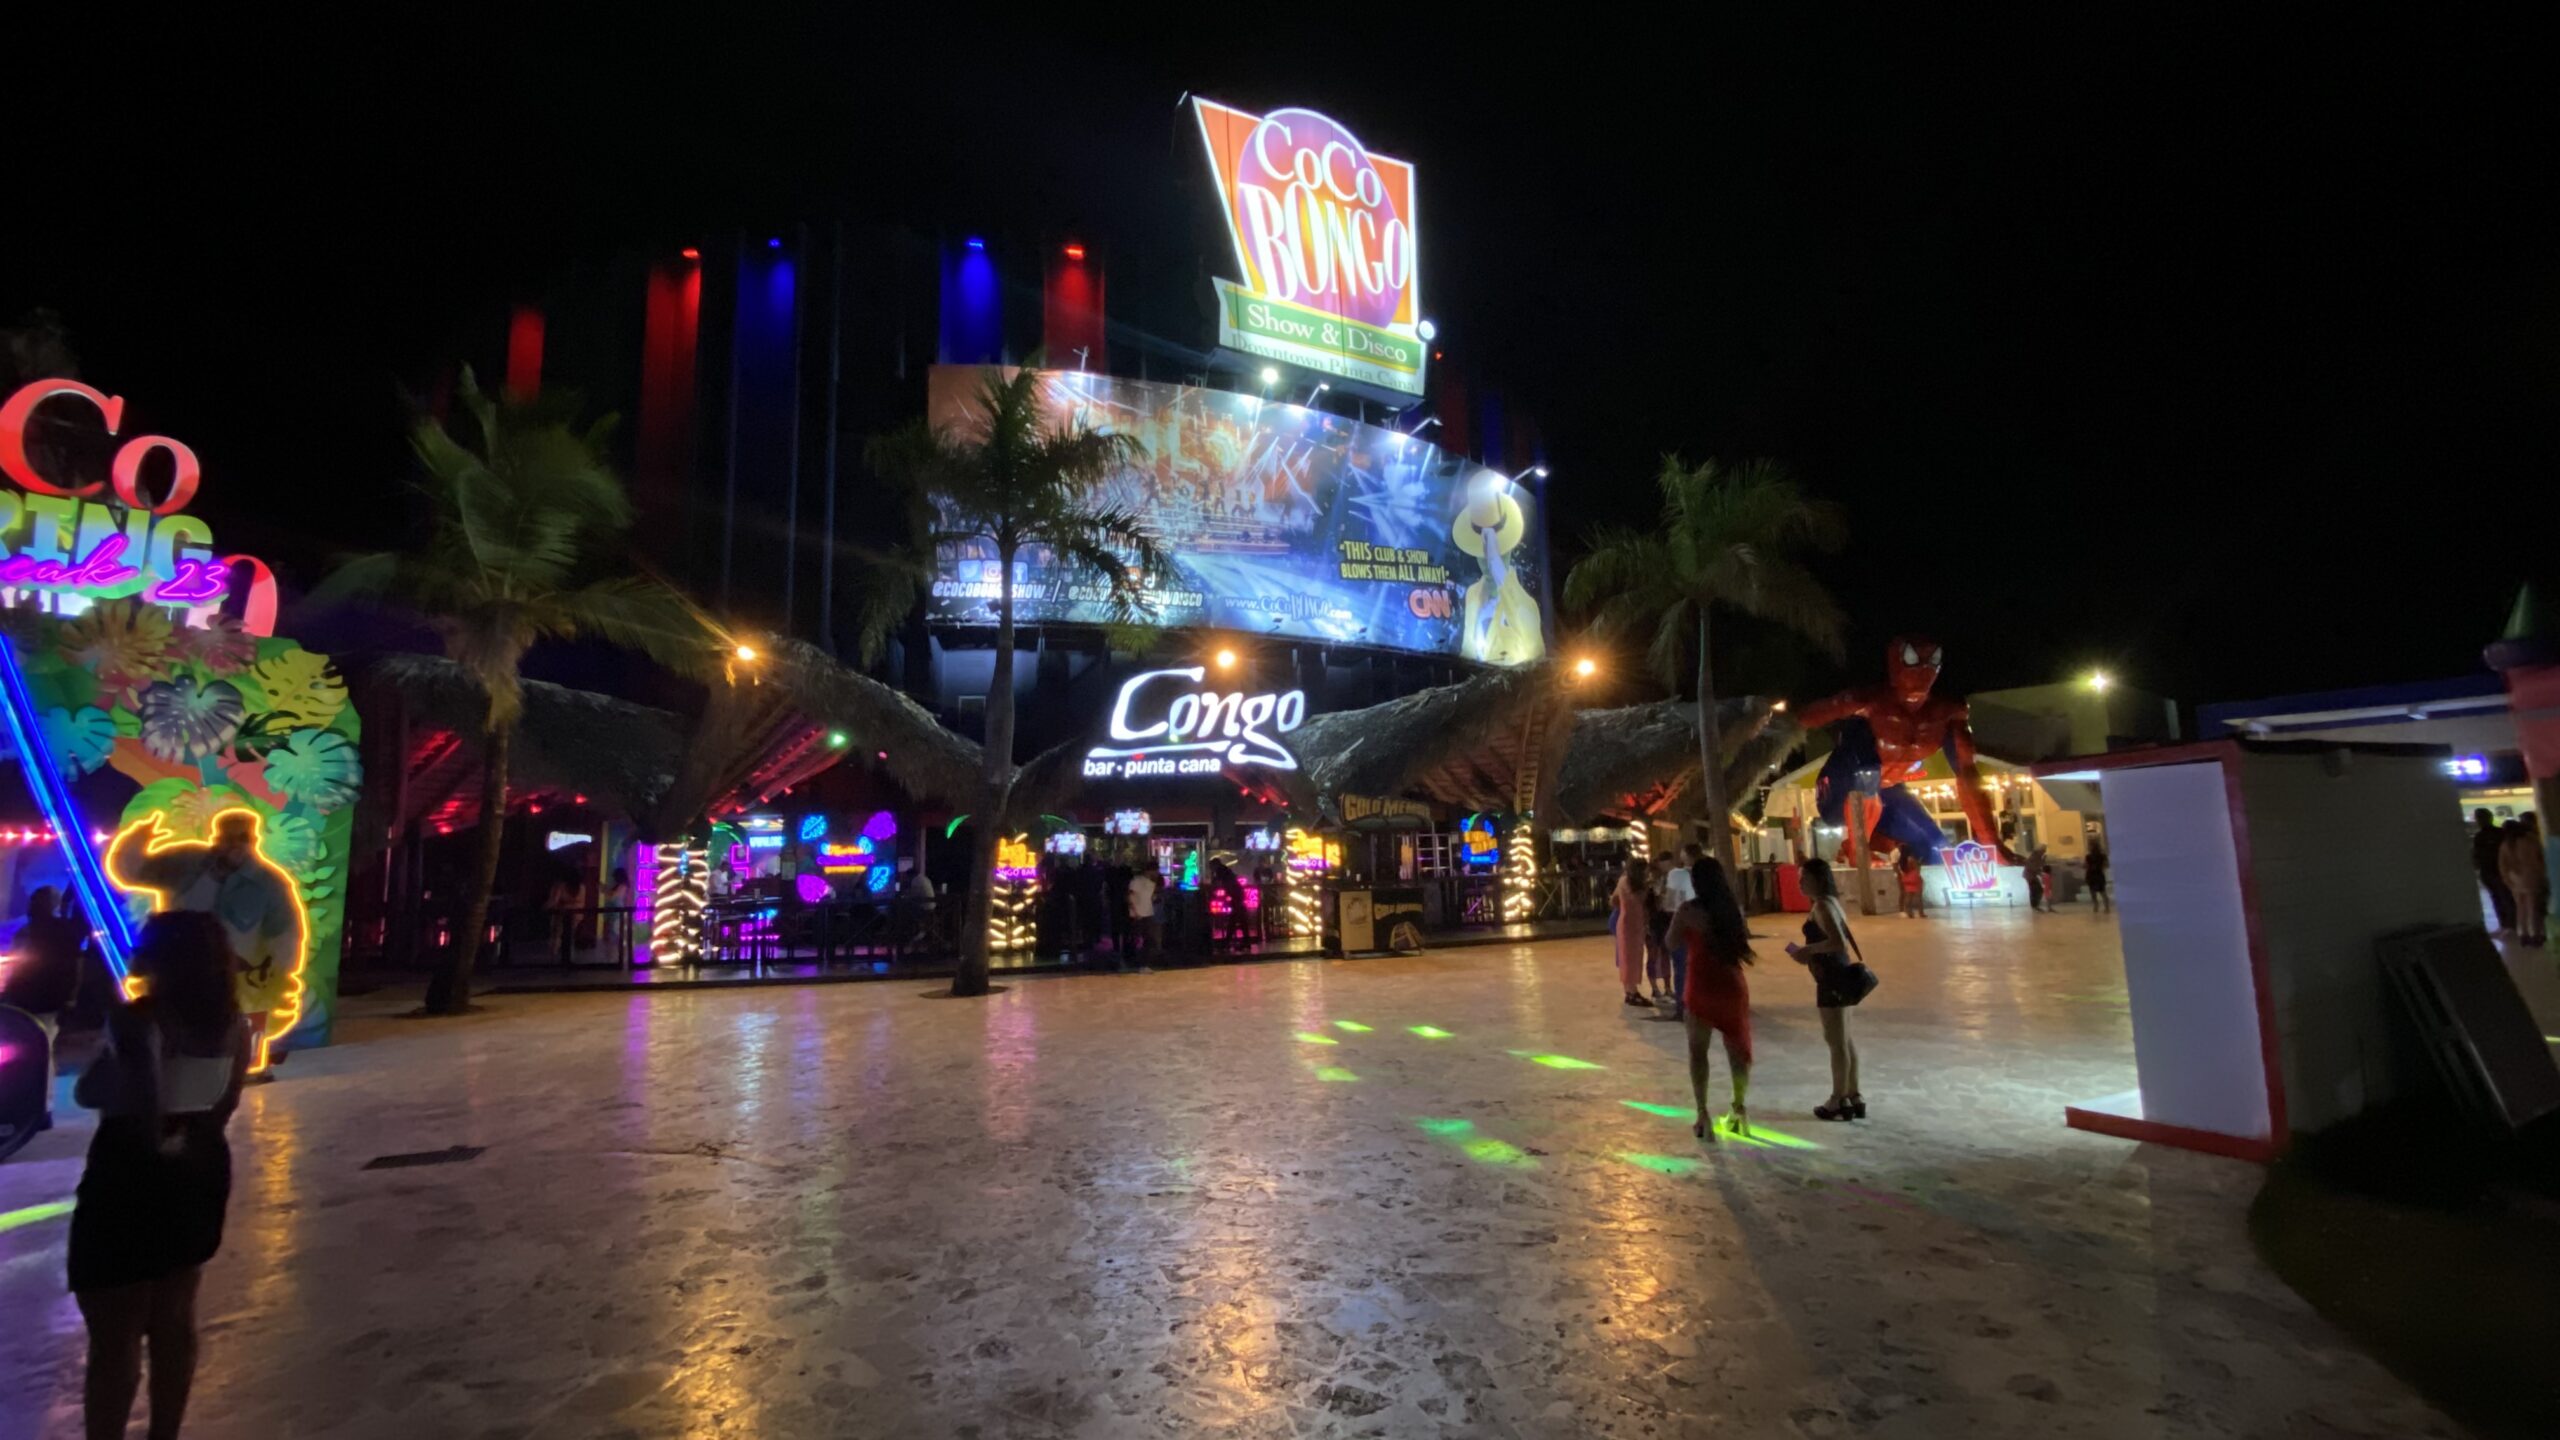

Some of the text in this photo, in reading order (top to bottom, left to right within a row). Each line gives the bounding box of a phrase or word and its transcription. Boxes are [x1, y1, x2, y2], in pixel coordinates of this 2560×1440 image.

[1239, 181, 1410, 301] BONGO
[1248, 304, 1408, 362] Show & Disco
[1232, 333, 1325, 370] Downtown
[1377, 371, 1416, 392] Cana
[1341, 563, 1373, 579] BLOWS
[1373, 564, 1398, 580] THEM
[1398, 564, 1416, 582] ALL
[1374, 547, 1396, 562] CLUB
[1405, 549, 1429, 564] SHOW
[156, 561, 226, 598] 23
[1409, 589, 1451, 619] CNN
[1111, 666, 1305, 769] Congo
[1124, 757, 1176, 779] punta
[1178, 757, 1221, 773] cana
